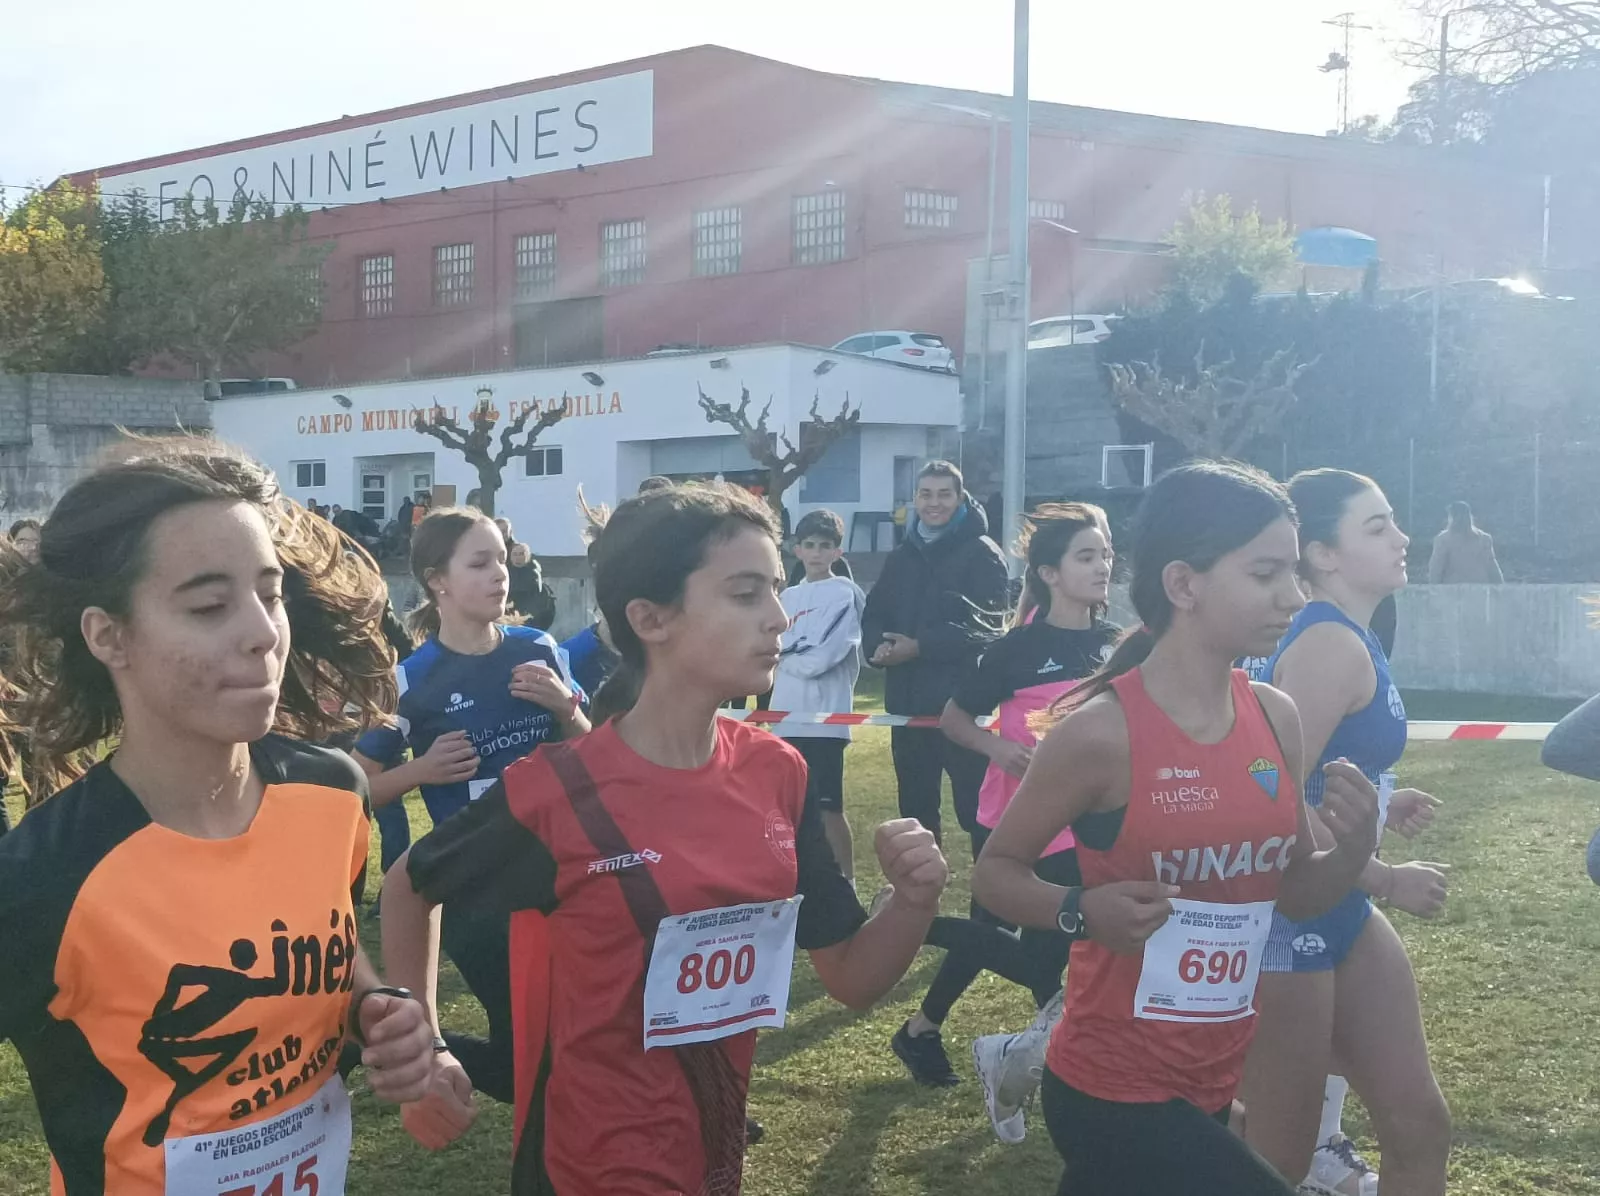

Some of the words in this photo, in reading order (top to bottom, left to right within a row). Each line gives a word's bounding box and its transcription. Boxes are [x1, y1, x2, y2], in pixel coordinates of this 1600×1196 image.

[272, 130, 387, 205] NINÉ
[410, 99, 599, 180] WINES
[297, 413, 353, 434] CAMPO
[465, 728, 494, 744] lub
[686, 924, 698, 932] EN
[1180, 918, 1191, 926] EN
[1193, 920, 1214, 929] EDAD
[1183, 911, 1214, 920] JUEGOS
[676, 944, 756, 994] 800
[1178, 948, 1248, 985] 690
[226, 1034, 302, 1086] club
[213, 1147, 229, 1160] EN
[231, 1138, 262, 1156] EDAD
[263, 1121, 303, 1147] ESCOLAR
[215, 1130, 259, 1149] JUEGOS
[261, 1103, 315, 1138] DEPORTIVOS
